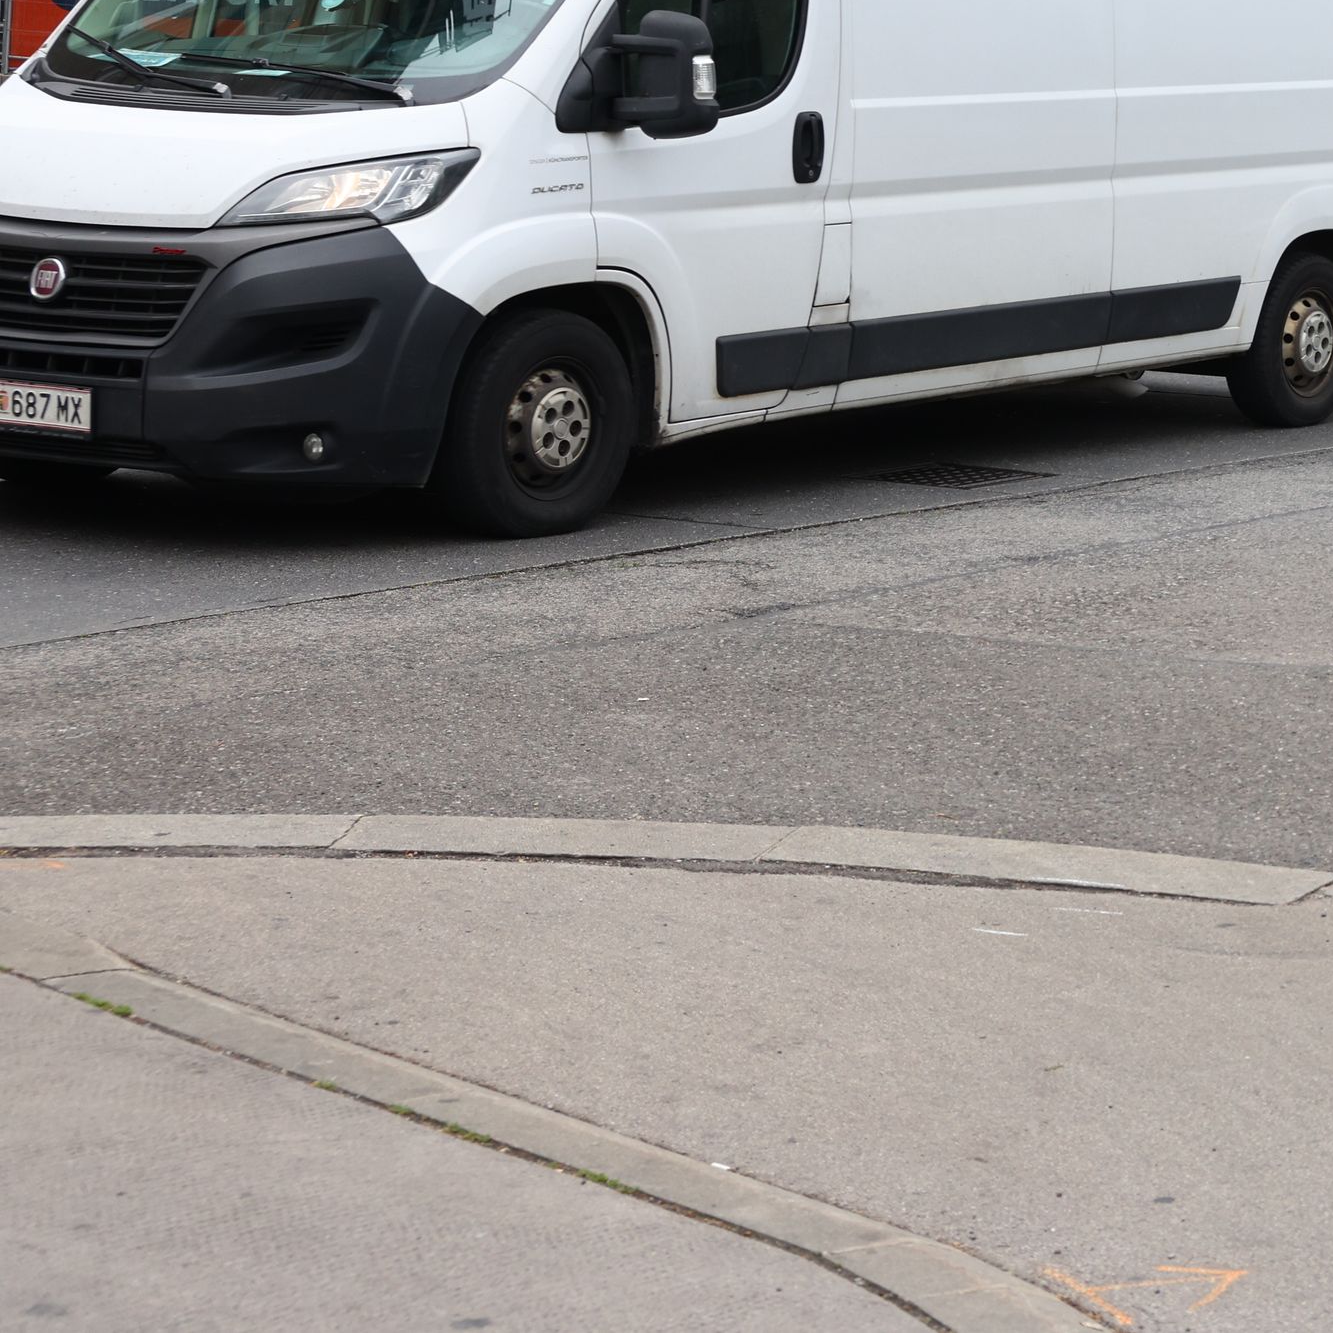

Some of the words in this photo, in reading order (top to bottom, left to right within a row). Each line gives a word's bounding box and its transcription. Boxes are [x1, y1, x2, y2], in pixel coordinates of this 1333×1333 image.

[531, 183, 584, 194] DUCATO
[36, 269, 58, 289] FIAT
[12, 390, 51, 419] 687
[57, 394, 82, 424] MX
